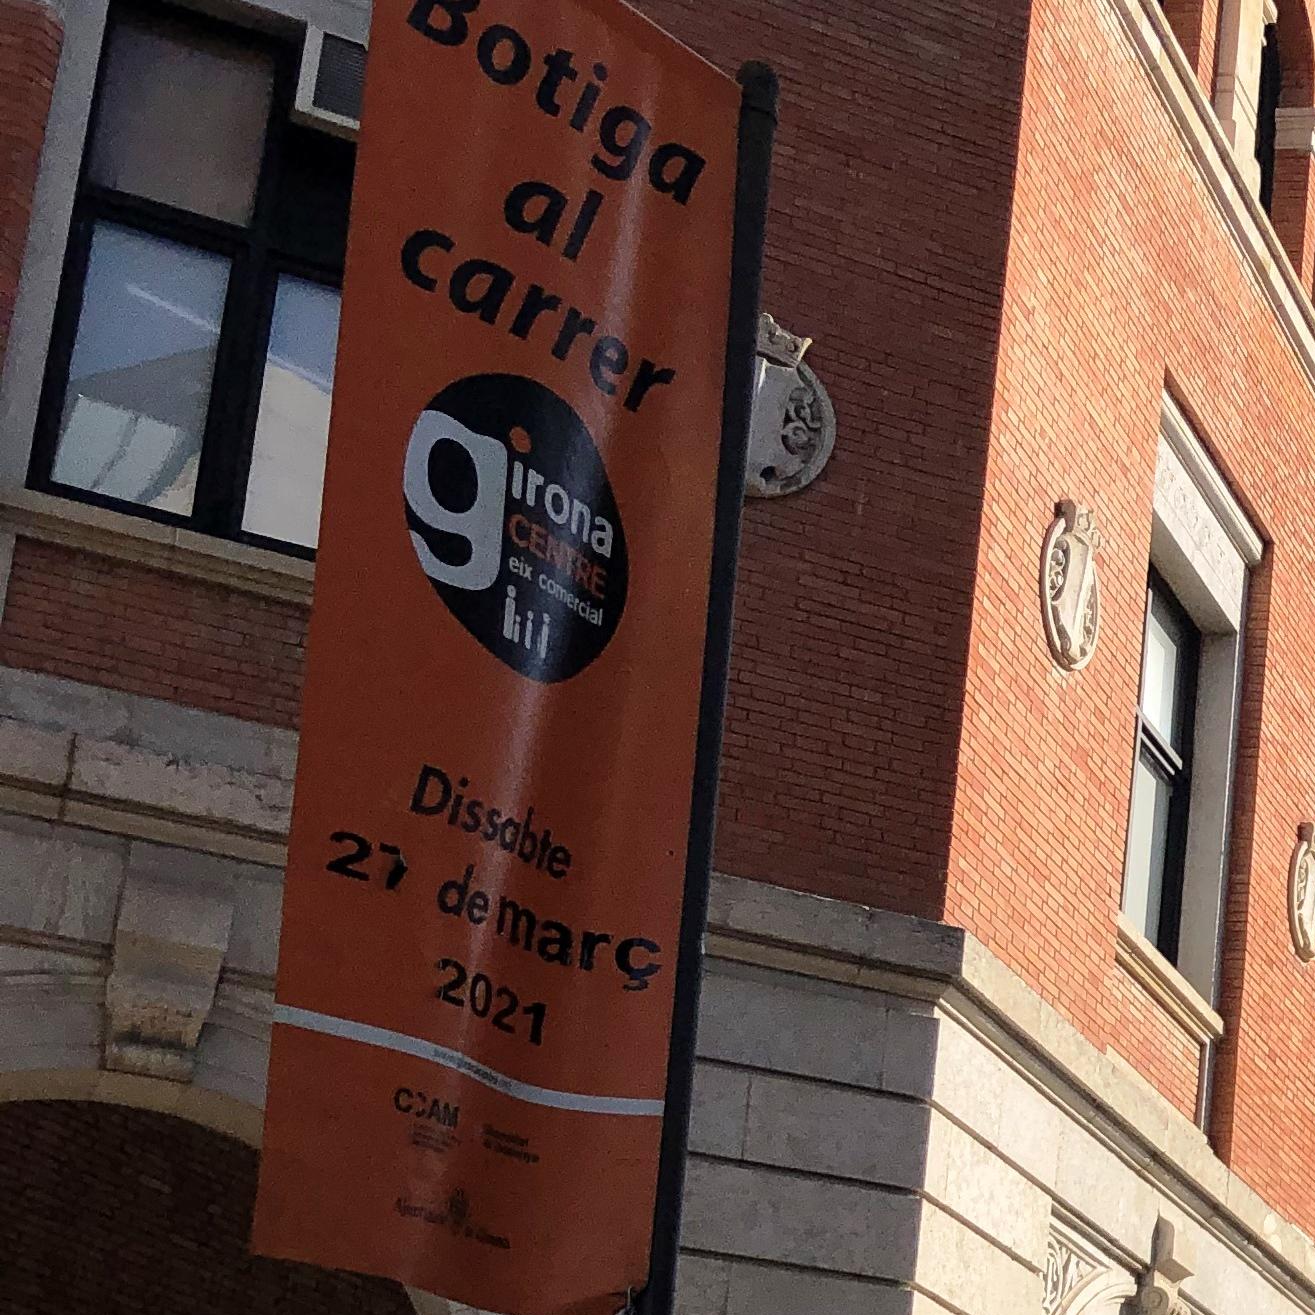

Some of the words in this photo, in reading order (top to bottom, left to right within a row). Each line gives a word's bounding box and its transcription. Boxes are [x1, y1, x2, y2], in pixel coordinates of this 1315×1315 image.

[407, 0, 707, 205] Botiga
[503, 180, 604, 262] al
[401, 227, 676, 413] carrer
[509, 513, 607, 599] CENTRE
[509, 556, 533, 580] eix
[538, 573, 604, 626] comercial
[409, 763, 572, 880] Dissable
[326, 831, 408, 890] 27
[437, 864, 489, 925] de
[499, 901, 662, 992] març
[435, 958, 547, 1047] 2021
